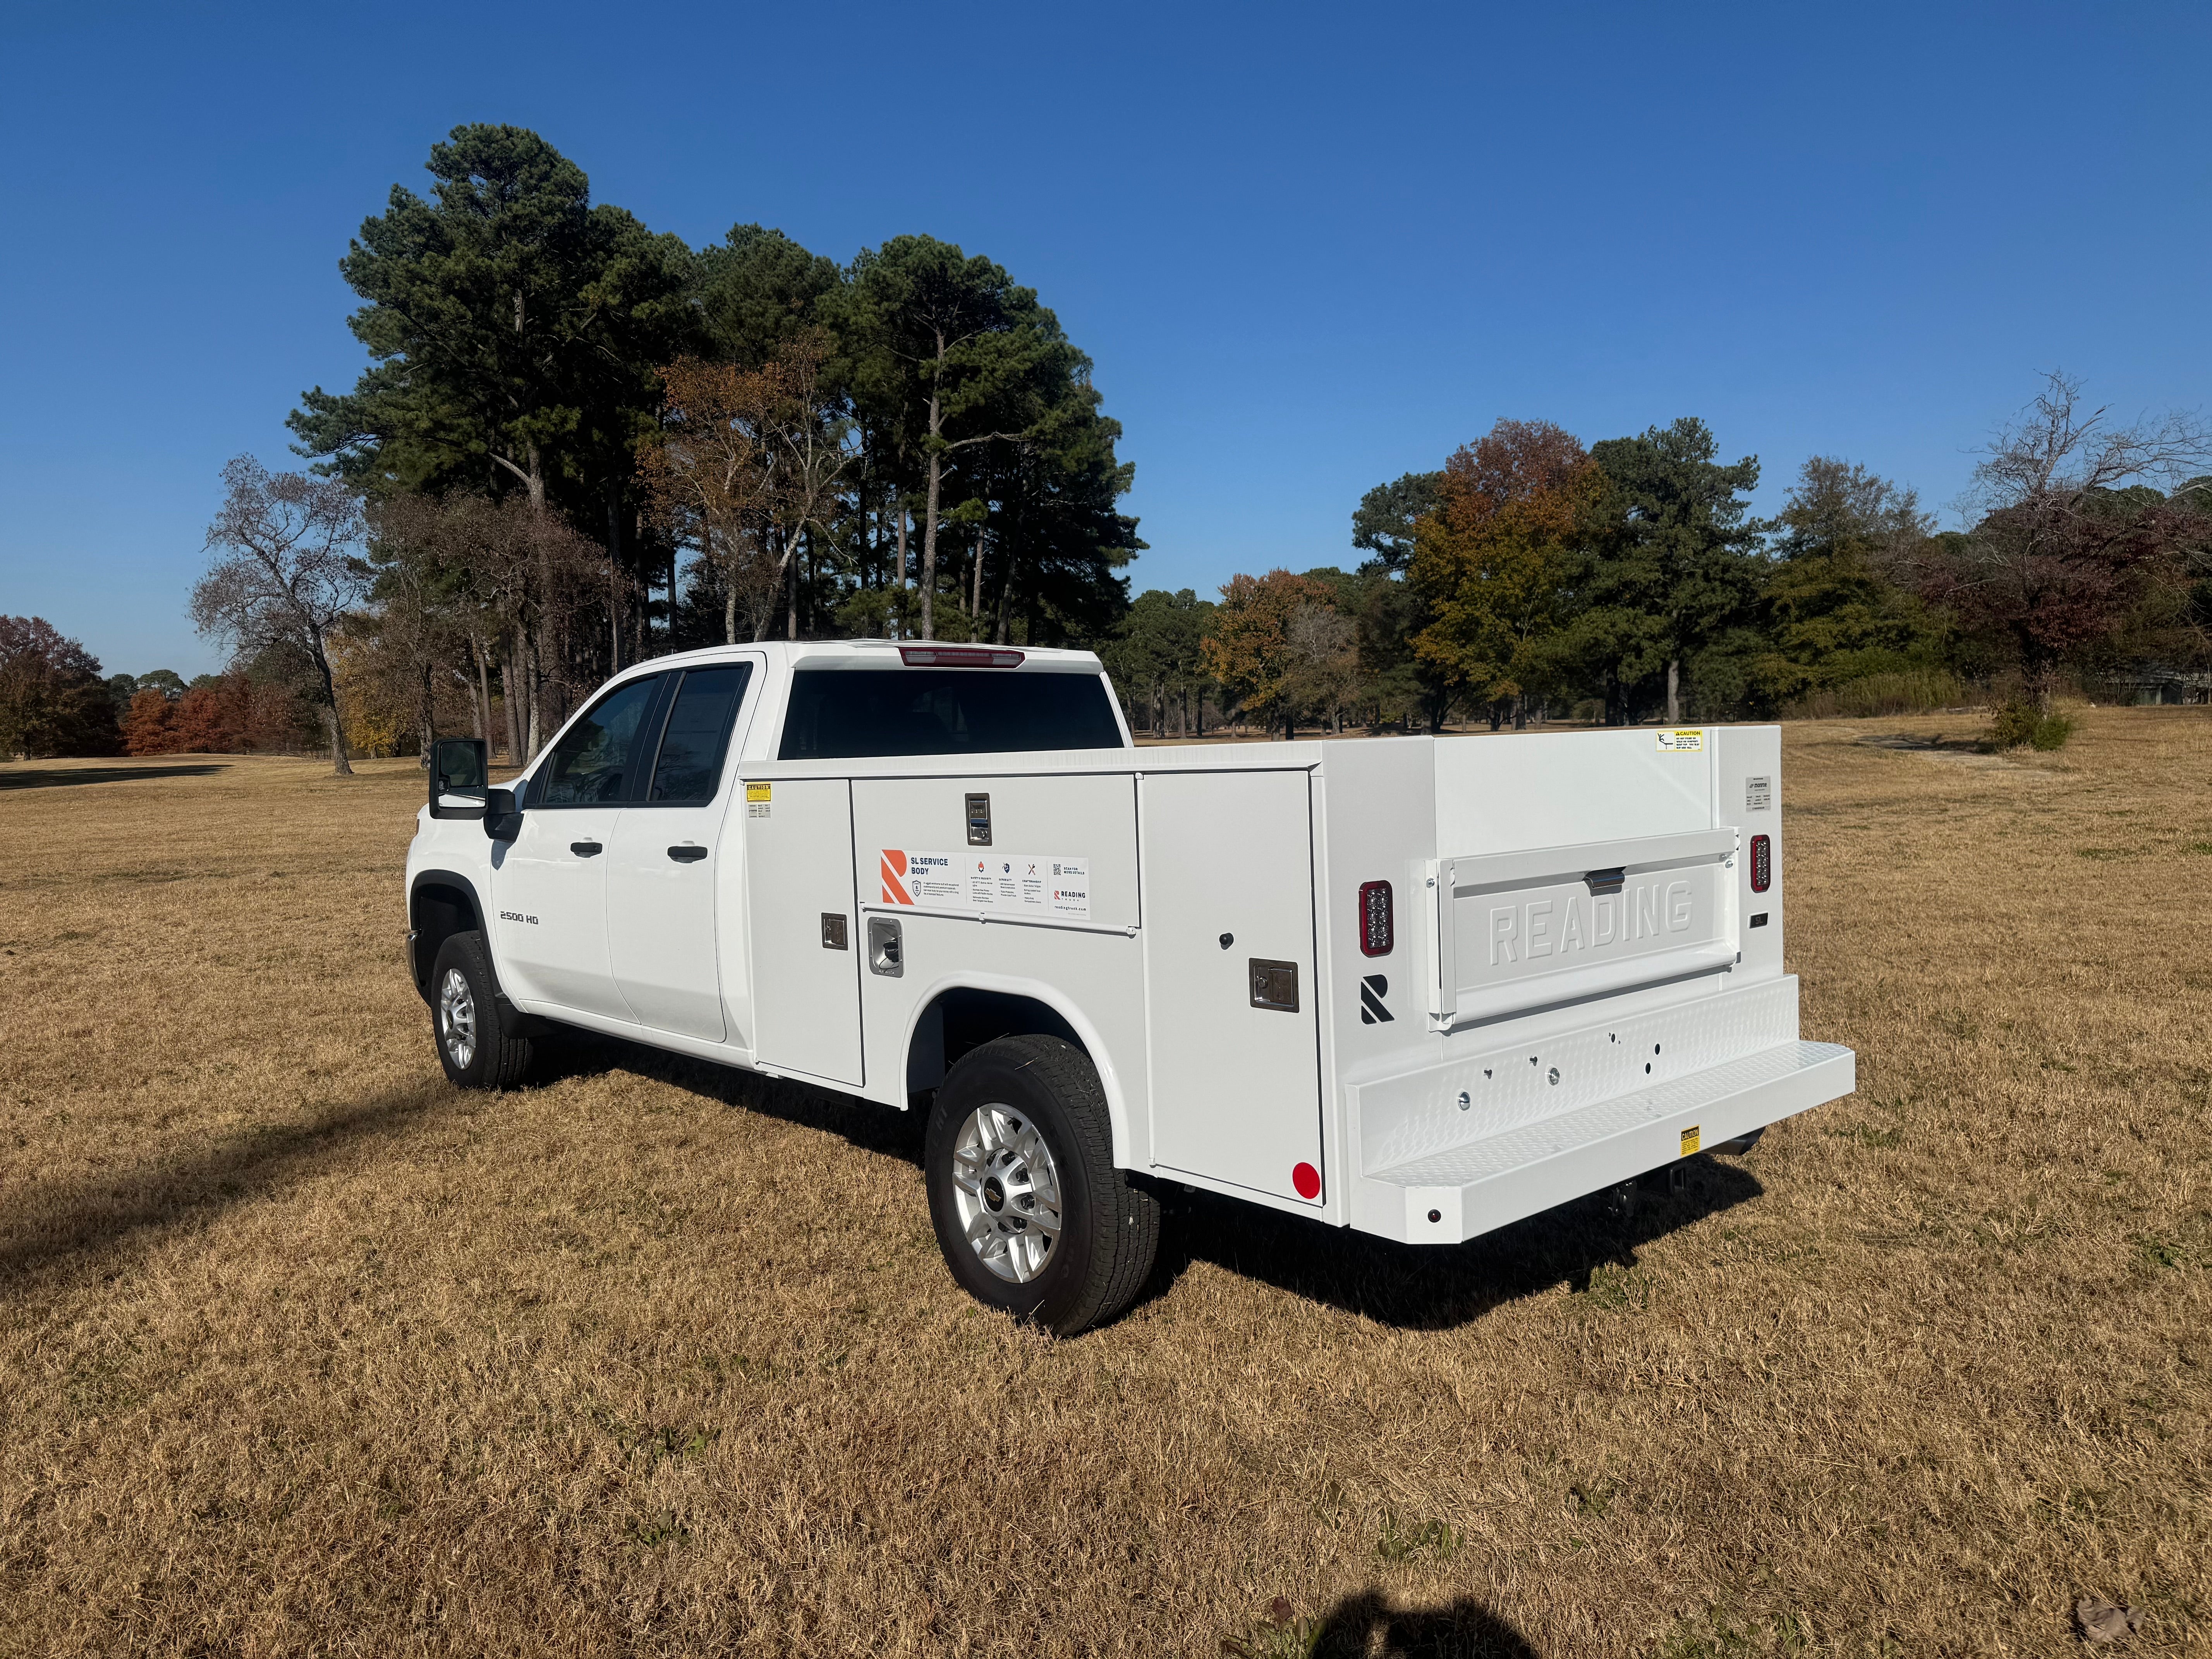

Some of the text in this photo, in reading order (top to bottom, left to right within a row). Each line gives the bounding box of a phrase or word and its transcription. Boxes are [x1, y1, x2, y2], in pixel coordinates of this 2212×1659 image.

[920, 857, 948, 866] SERVICE
[500, 911, 539, 925] 2500 HD
[1490, 880, 1692, 966] READING
[1755, 916, 1763, 924] SL
[1682, 1128, 1698, 1140] CAUTION
